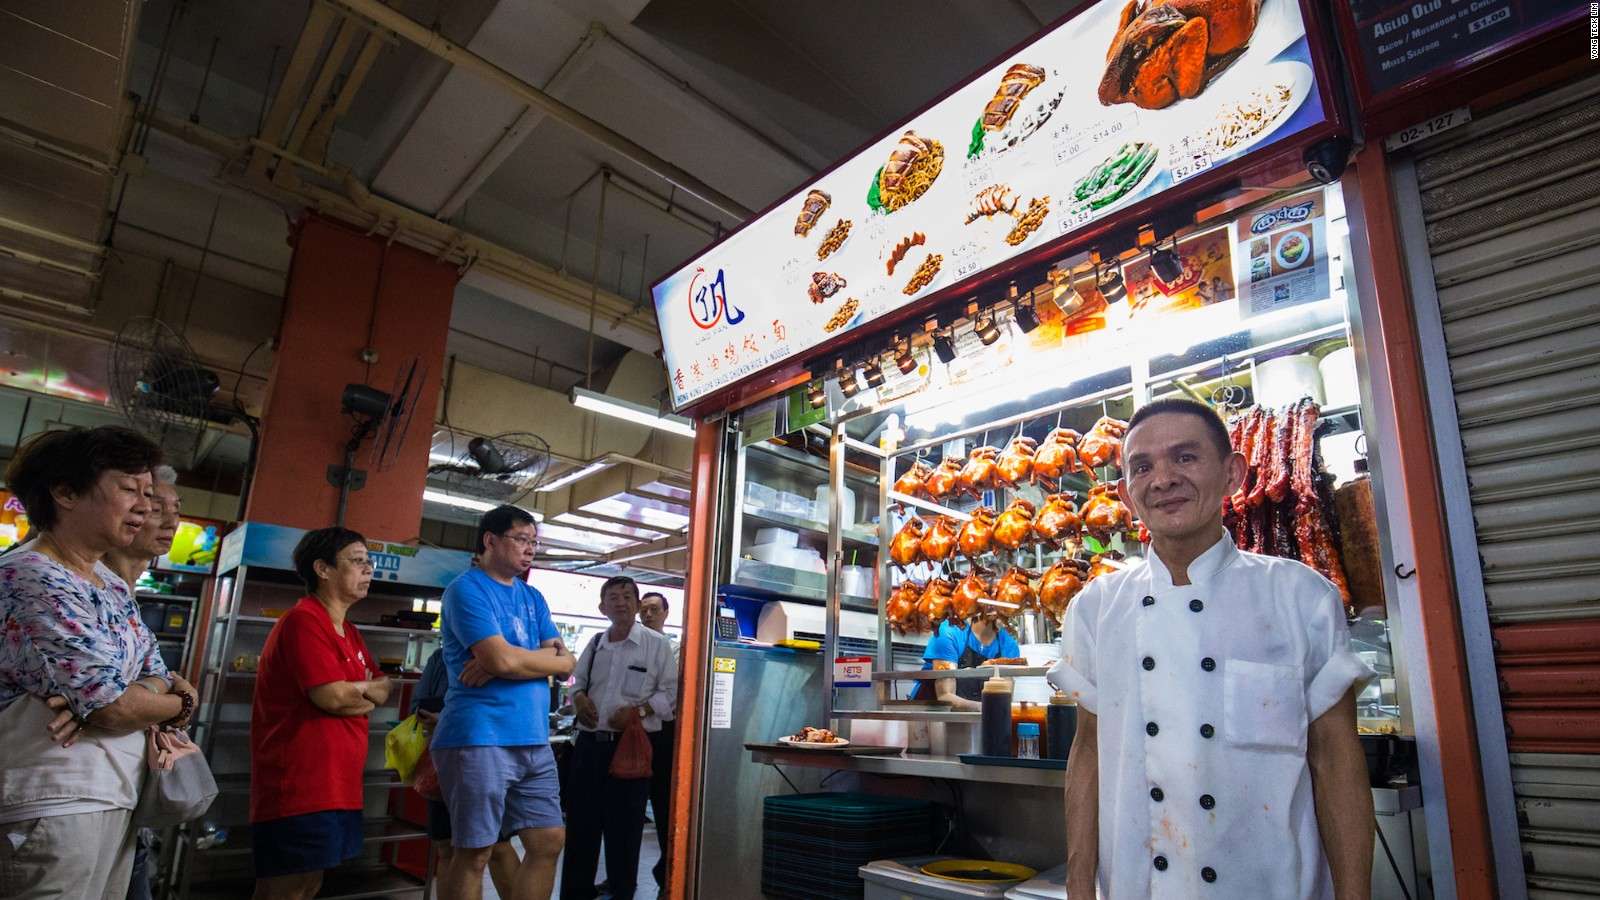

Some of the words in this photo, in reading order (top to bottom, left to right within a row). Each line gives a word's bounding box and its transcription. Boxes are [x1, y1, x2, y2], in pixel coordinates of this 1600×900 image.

[1375, 14, 1409, 38] AGLIO
[1473, 11, 1506, 30] $1.00
[1400, 113, 1453, 143] 02-127
[371, 555, 398, 569] ALAL
